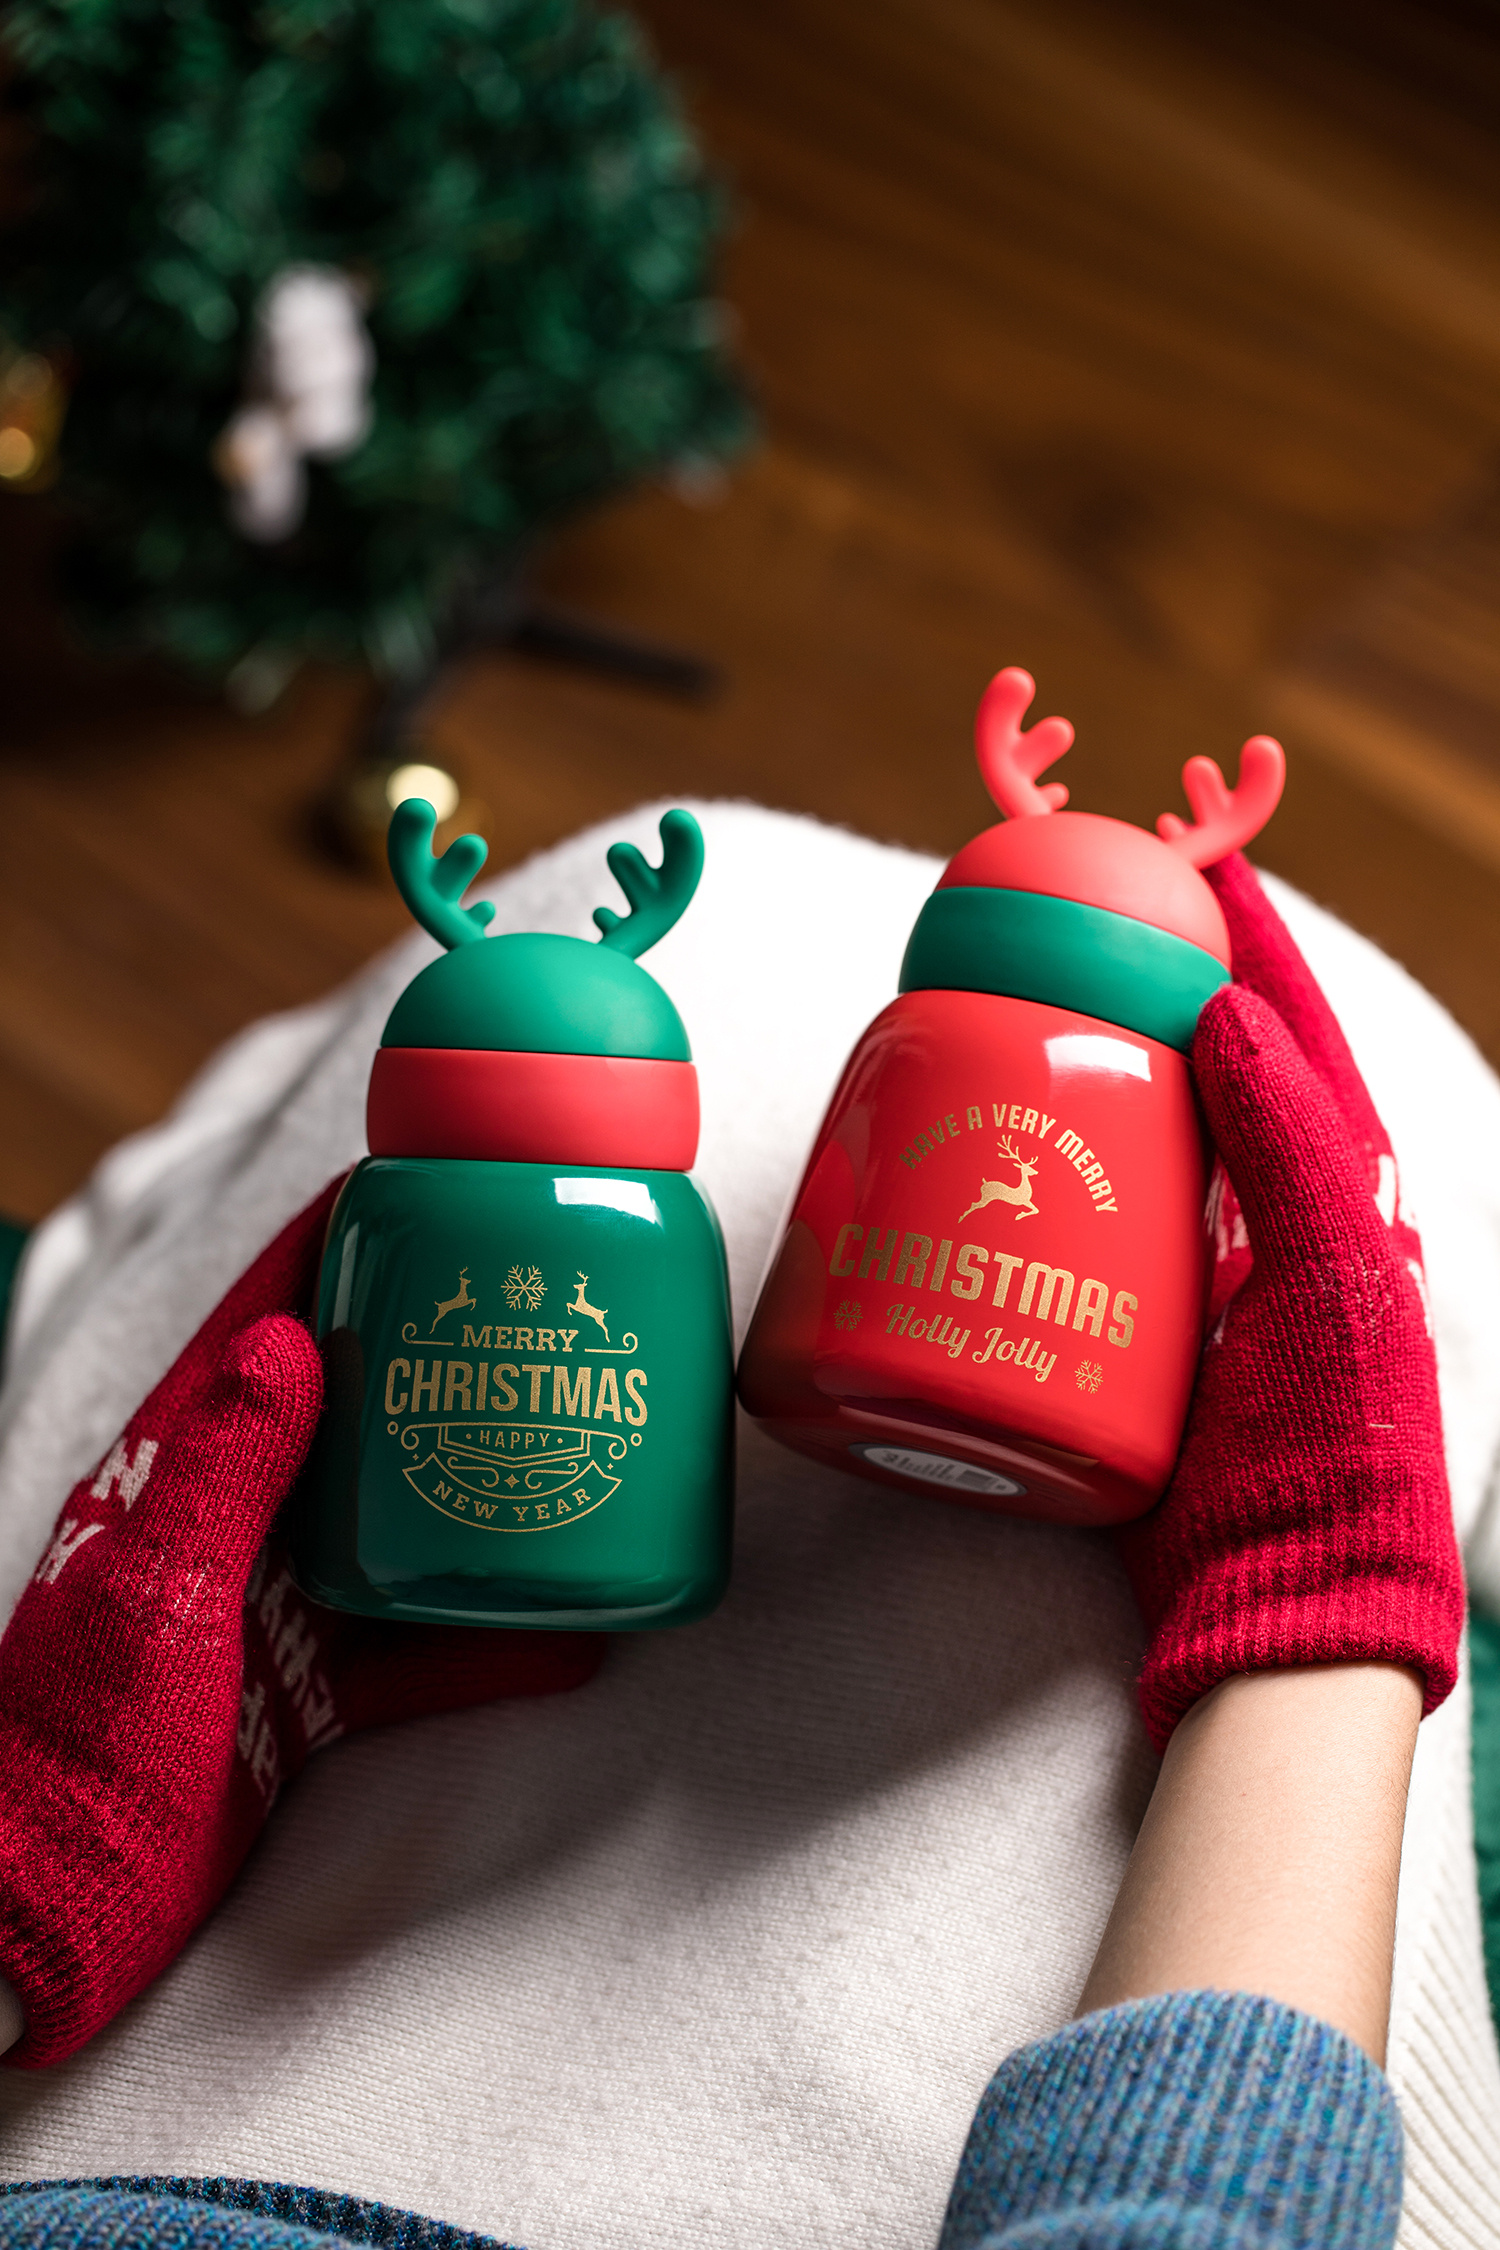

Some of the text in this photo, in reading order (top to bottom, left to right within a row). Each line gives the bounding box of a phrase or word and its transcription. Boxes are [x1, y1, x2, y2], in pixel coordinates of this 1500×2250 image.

[899, 1103, 1119, 1213] HAVE A VERY MERRY
[829, 1224, 1139, 1349] CHRISTMAS
[461, 1325, 579, 1352] MERRY
[885, 1303, 1058, 1383] Holly Jolly
[385, 1358, 648, 1427] CHRISTMAS
[479, 1430, 551, 1450] HAPPY
[432, 1481, 591, 1522] NEW YEAR
